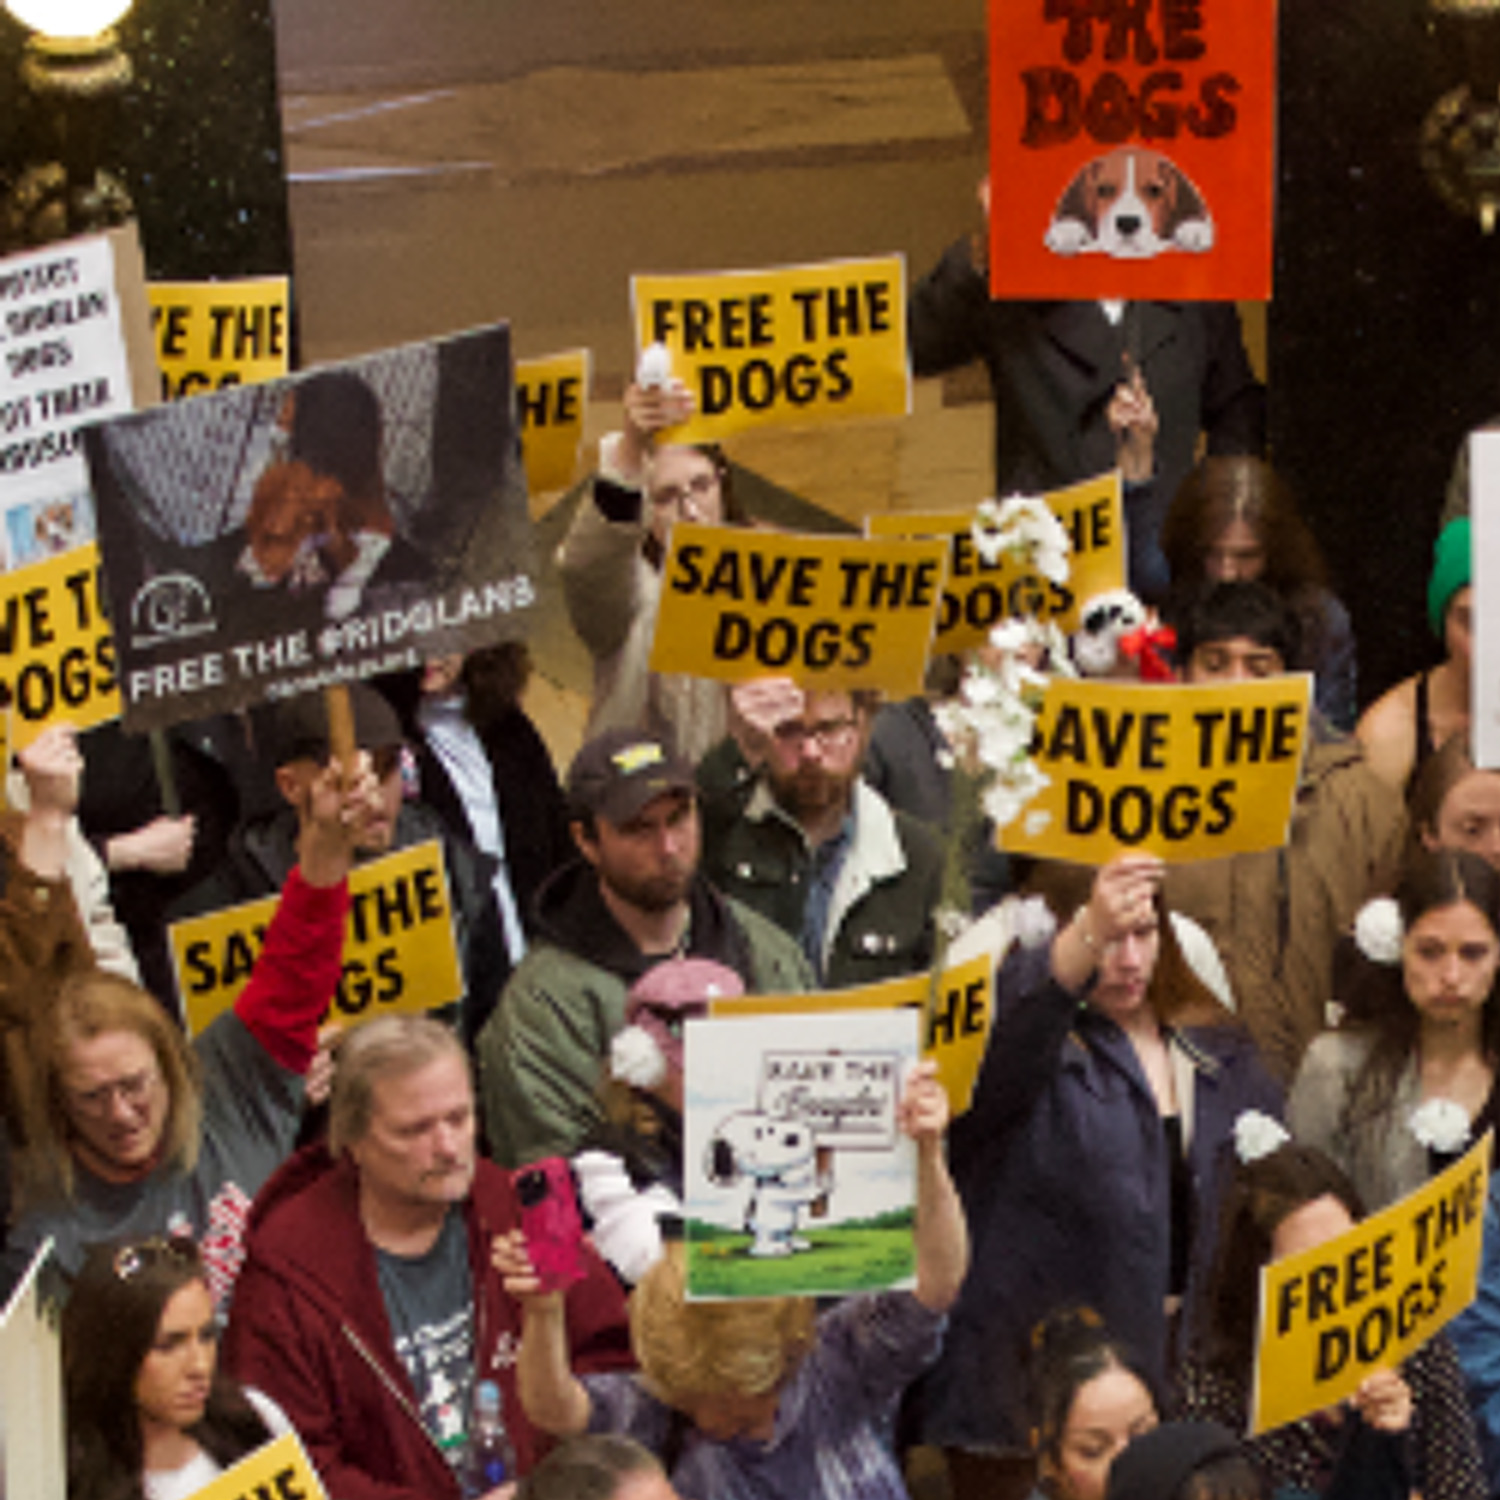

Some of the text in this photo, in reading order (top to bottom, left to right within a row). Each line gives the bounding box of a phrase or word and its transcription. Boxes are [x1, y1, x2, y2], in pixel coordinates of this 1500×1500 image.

[1042, 0, 1207, 67] THE
[1019, 67, 1242, 150] DOGS
[208, 304, 284, 361] THE
[652, 280, 890, 353] FREE THE
[520, 376, 578, 428] HE
[697, 349, 854, 416] DOGS
[670, 545, 938, 609] SAVE THE
[130, 653, 225, 702] FREE
[232, 633, 311, 678] THE
[712, 610, 877, 670] DOGS
[1193, 701, 1300, 769] THE
[1065, 778, 1237, 846] DOGS
[185, 867, 444, 996] SA THE
[318, 947, 406, 1026] GS
[928, 977, 985, 1051] HE
[845, 1060, 893, 1081] THE
[1278, 1168, 1483, 1338] FREE THE
[1315, 1258, 1448, 1384] DOGS
